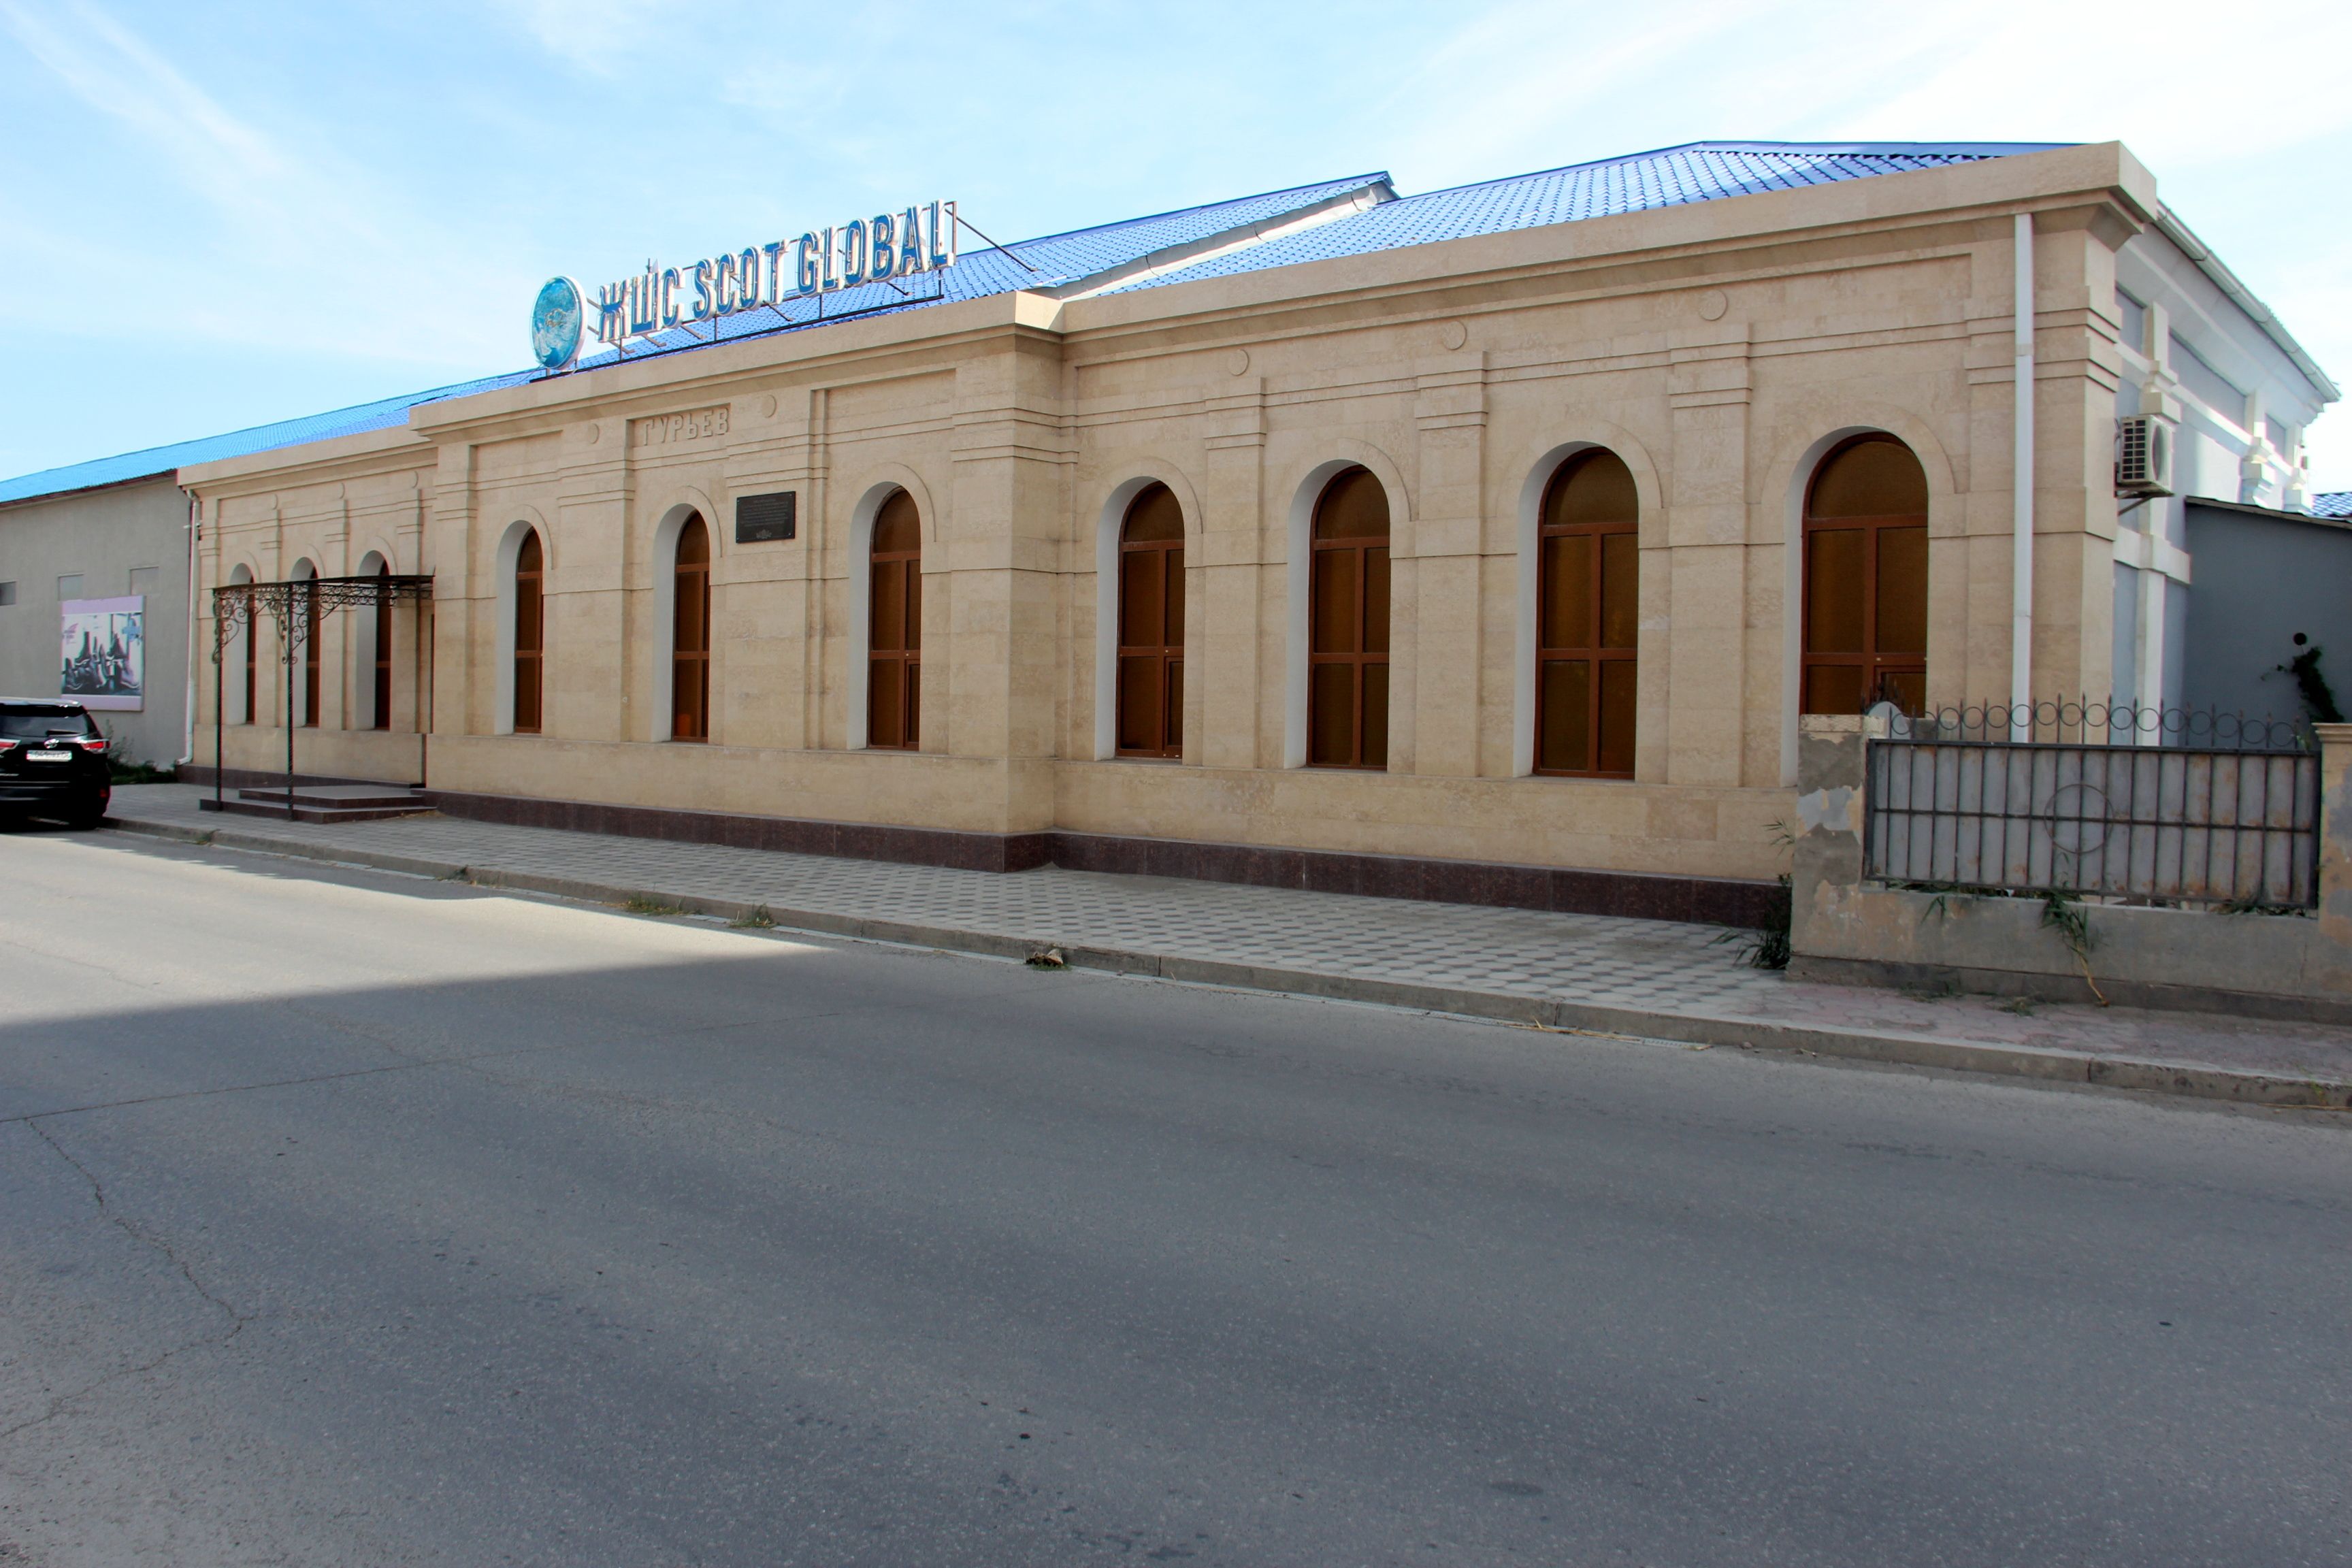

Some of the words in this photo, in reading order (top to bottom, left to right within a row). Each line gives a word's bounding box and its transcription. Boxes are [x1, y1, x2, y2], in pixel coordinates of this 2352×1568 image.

[598, 266, 685, 344] ЖШС
[692, 240, 789, 322] SCOT
[796, 199, 955, 298] GLOBAL
[642, 408, 731, 446] ГУРЬЕВ
